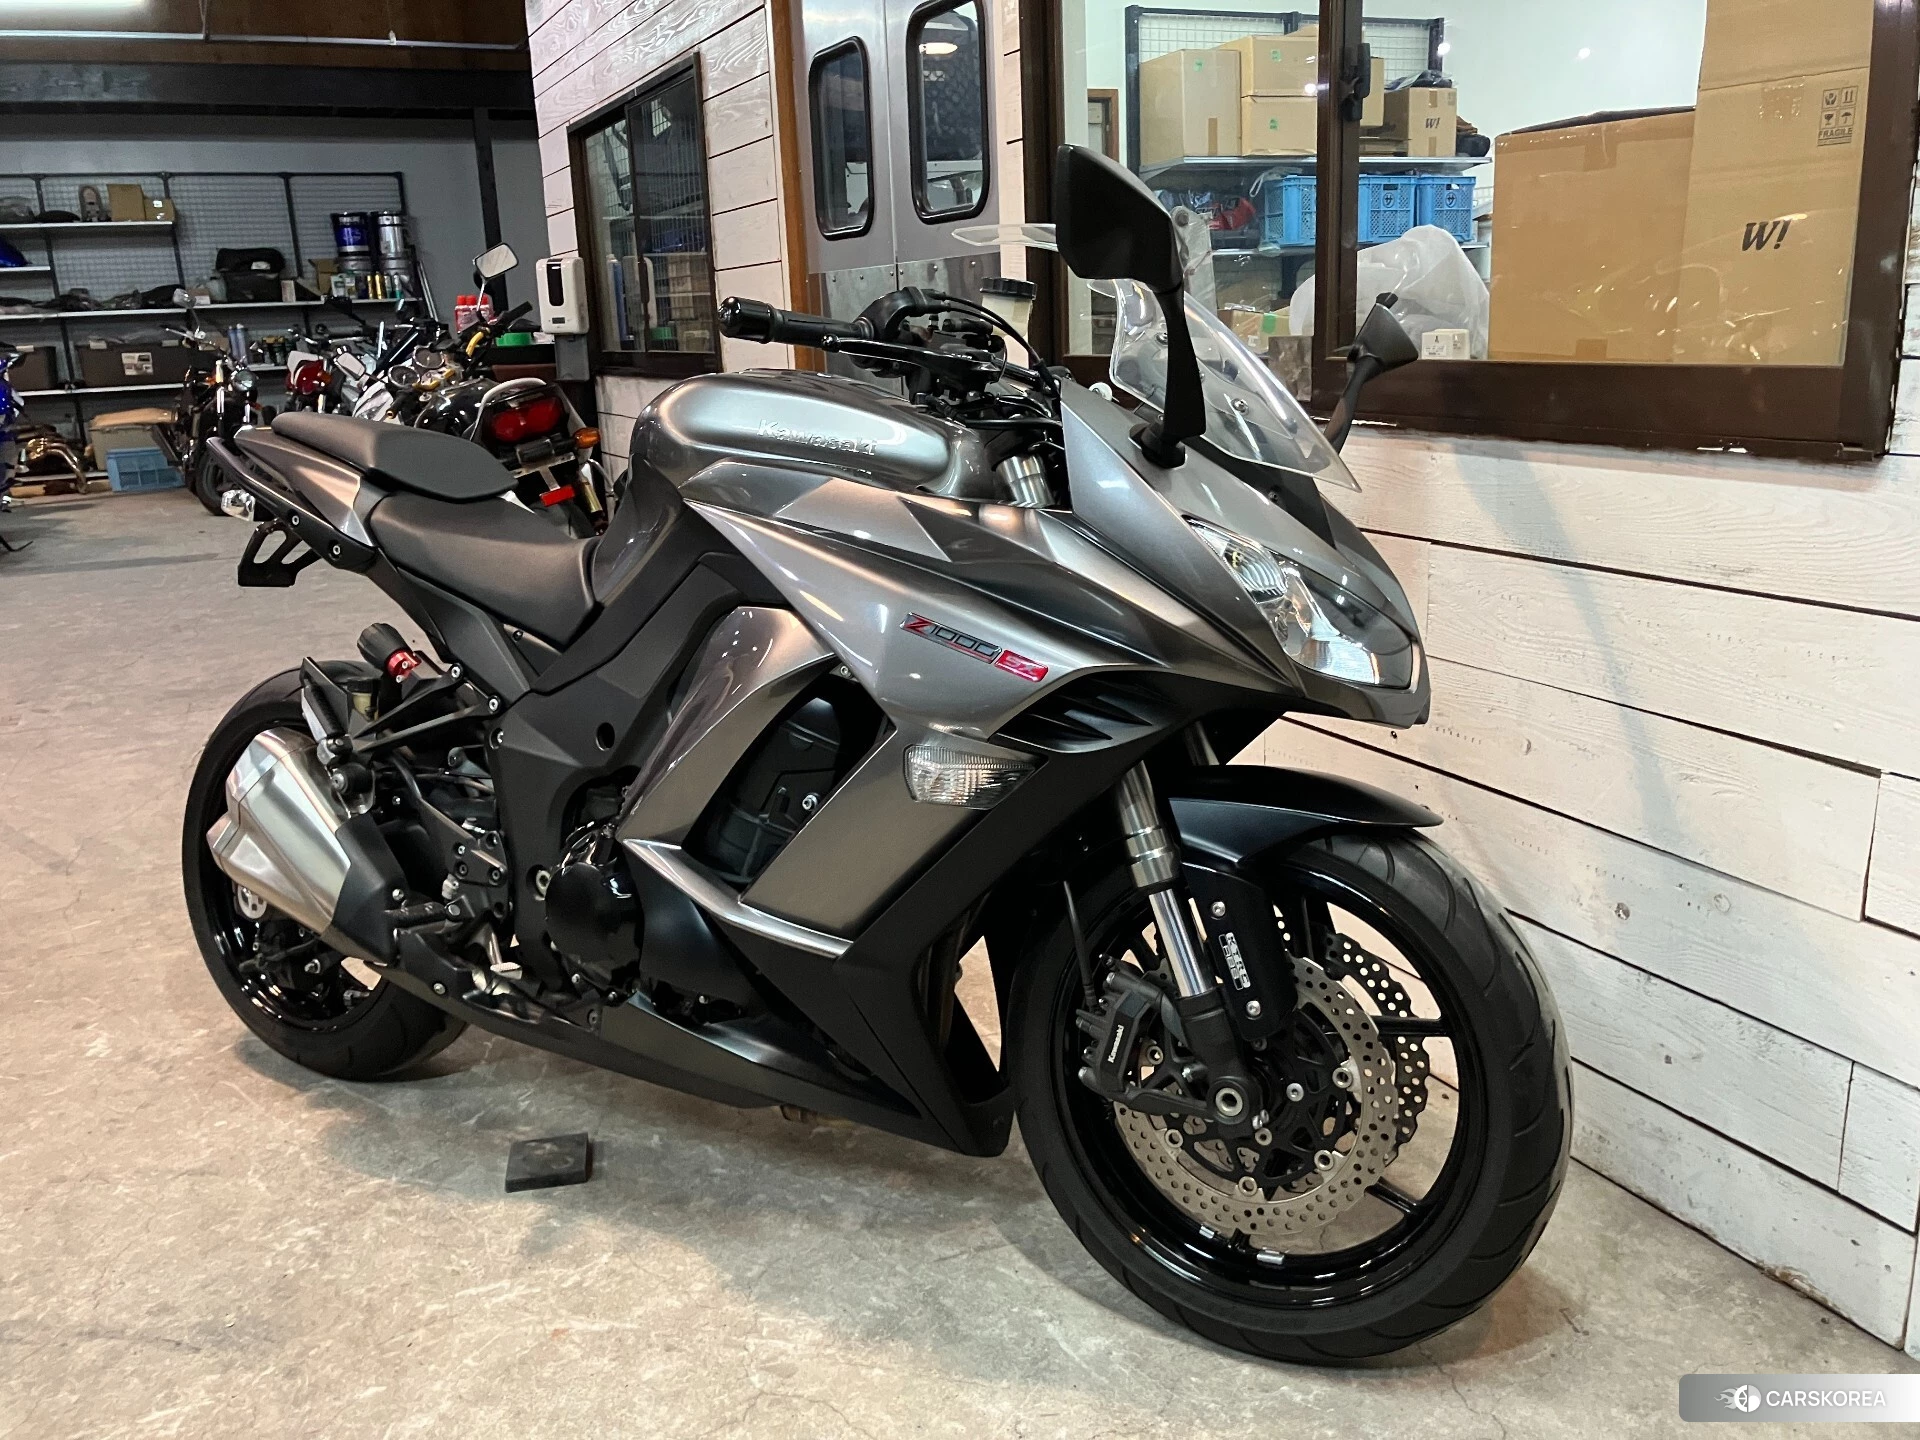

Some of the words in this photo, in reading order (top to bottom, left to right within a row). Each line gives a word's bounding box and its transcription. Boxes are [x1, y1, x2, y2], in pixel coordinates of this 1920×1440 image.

[1425, 117, 1440, 129] W!
[1818, 127, 1853, 139] FRAGILE
[1741, 220, 1791, 251] W!
[757, 419, 877, 456] Kawasaki
[904, 615, 1000, 656] Z1000
[1107, 1024, 1124, 1063] Kawasaki
